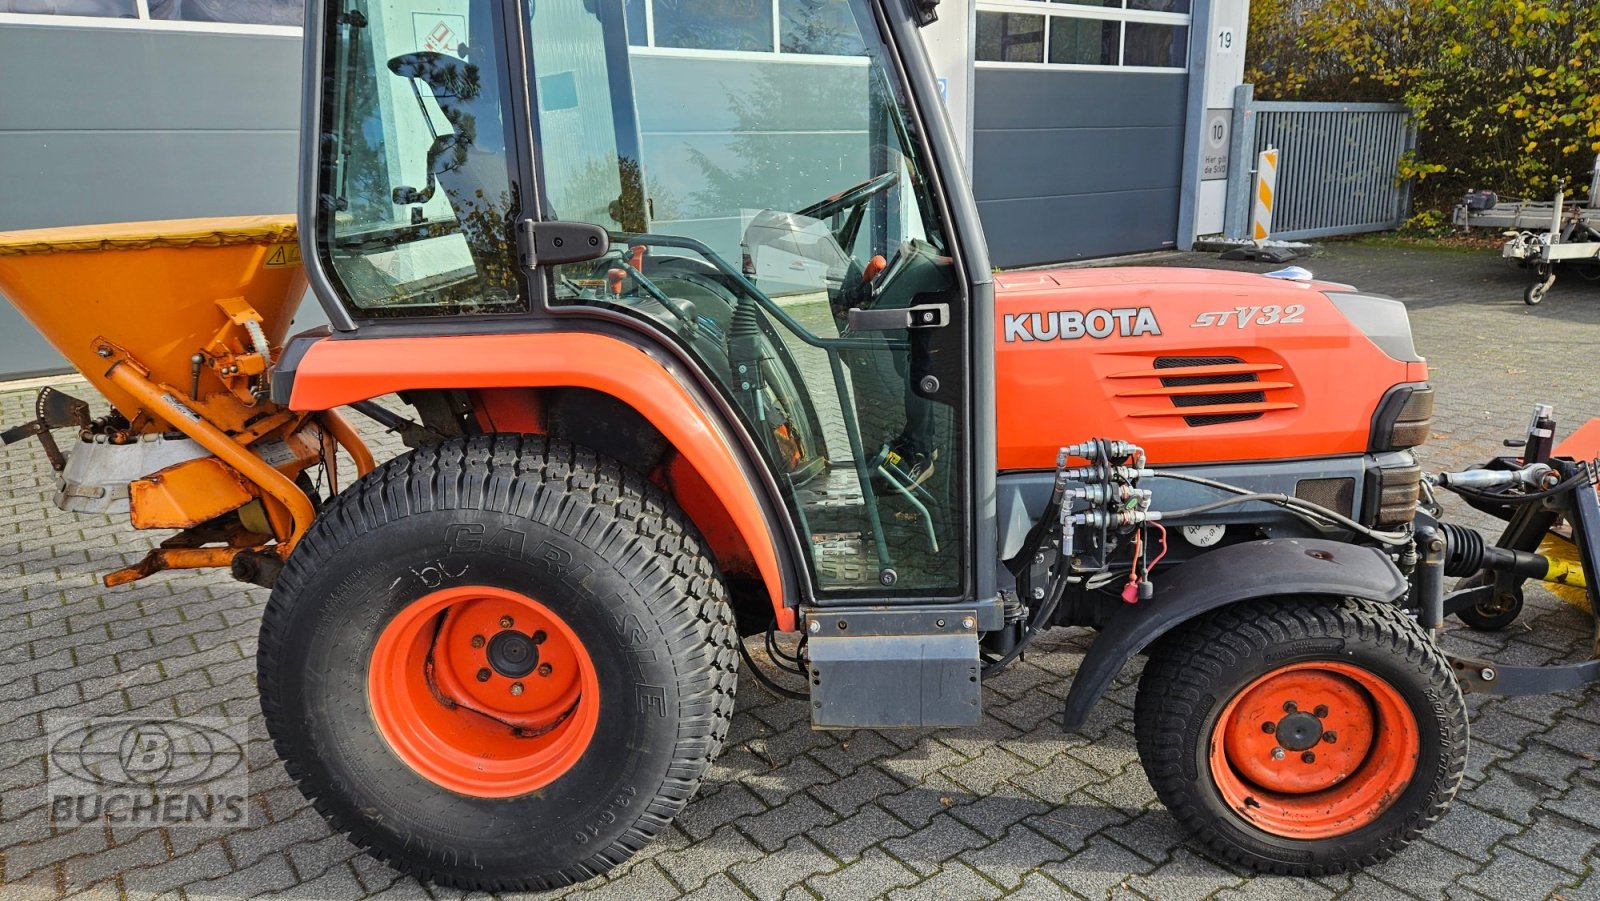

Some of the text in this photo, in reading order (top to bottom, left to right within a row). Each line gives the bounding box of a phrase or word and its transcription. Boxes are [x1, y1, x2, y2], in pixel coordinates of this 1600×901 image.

[1218, 31, 1231, 48] 19
[1213, 124, 1223, 140] 10
[1003, 306, 1162, 343] KUBOTA
